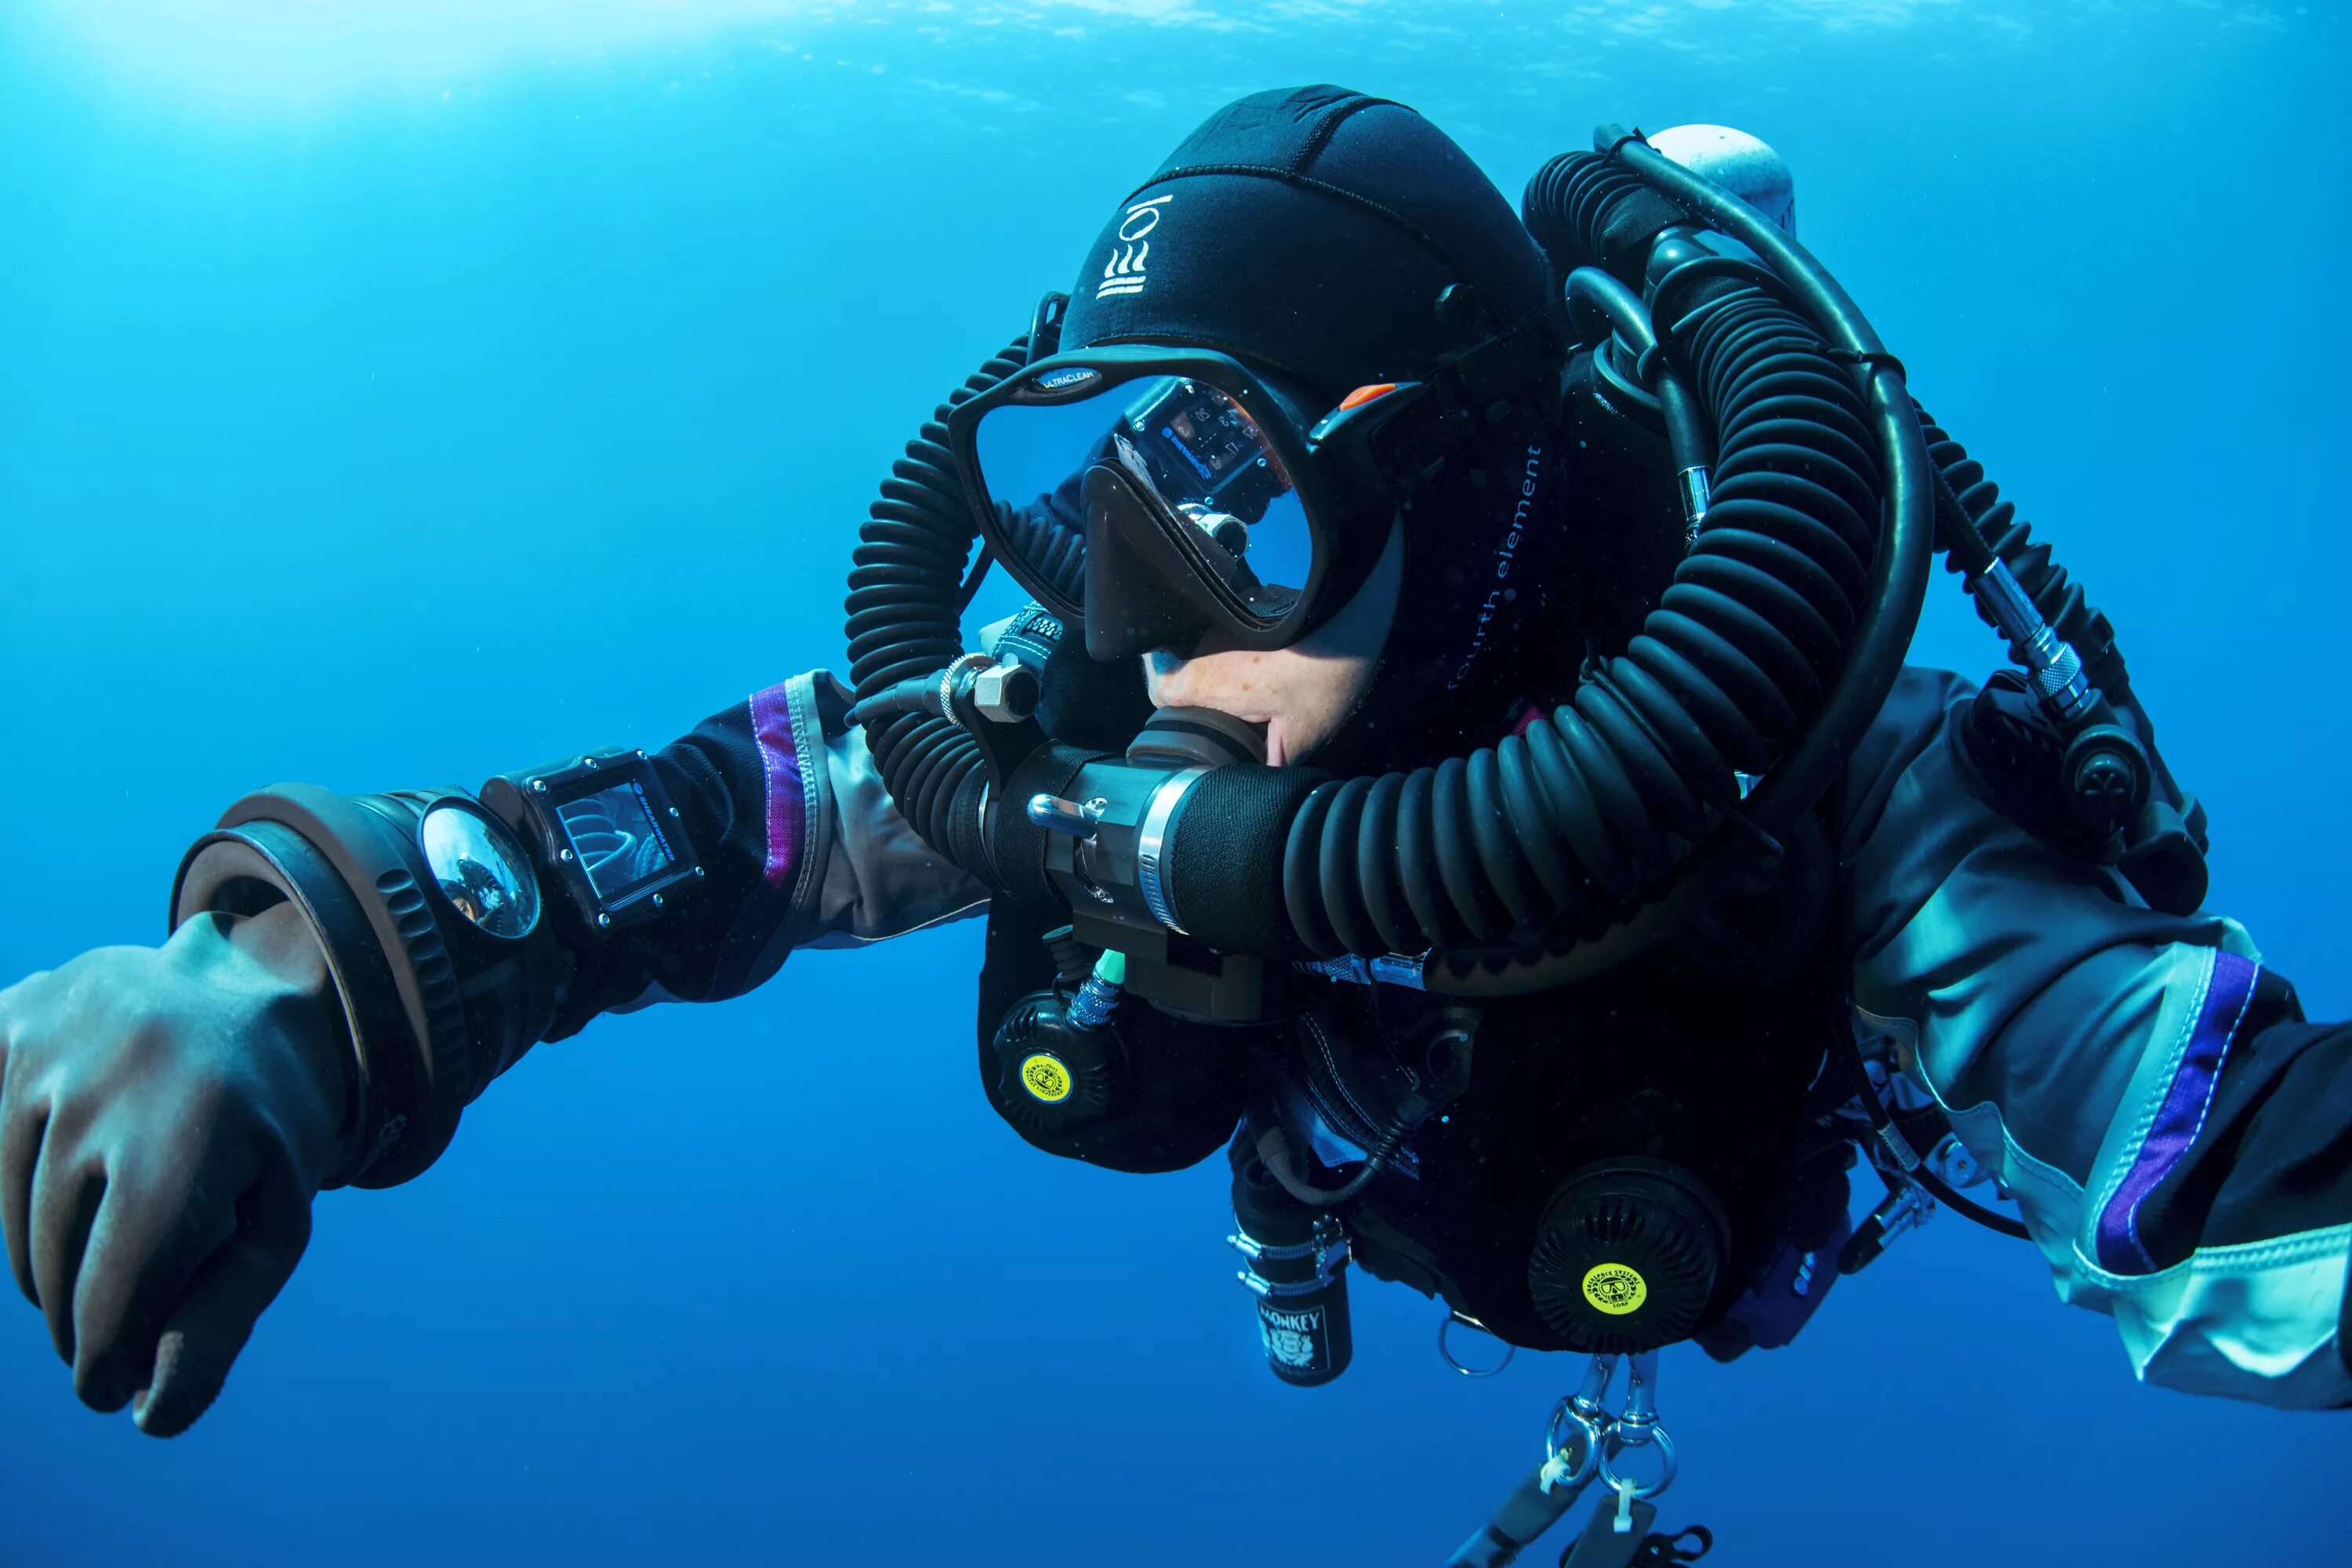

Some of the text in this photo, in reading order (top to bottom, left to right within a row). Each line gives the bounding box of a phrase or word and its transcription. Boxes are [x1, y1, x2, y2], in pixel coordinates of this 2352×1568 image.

[1447, 445, 1541, 691] fourth element
[639, 796, 675, 861] SHEARWATER
[1614, 1269, 1641, 1285] SYSTEMS
[1260, 1306, 1321, 1333] MONKEY
